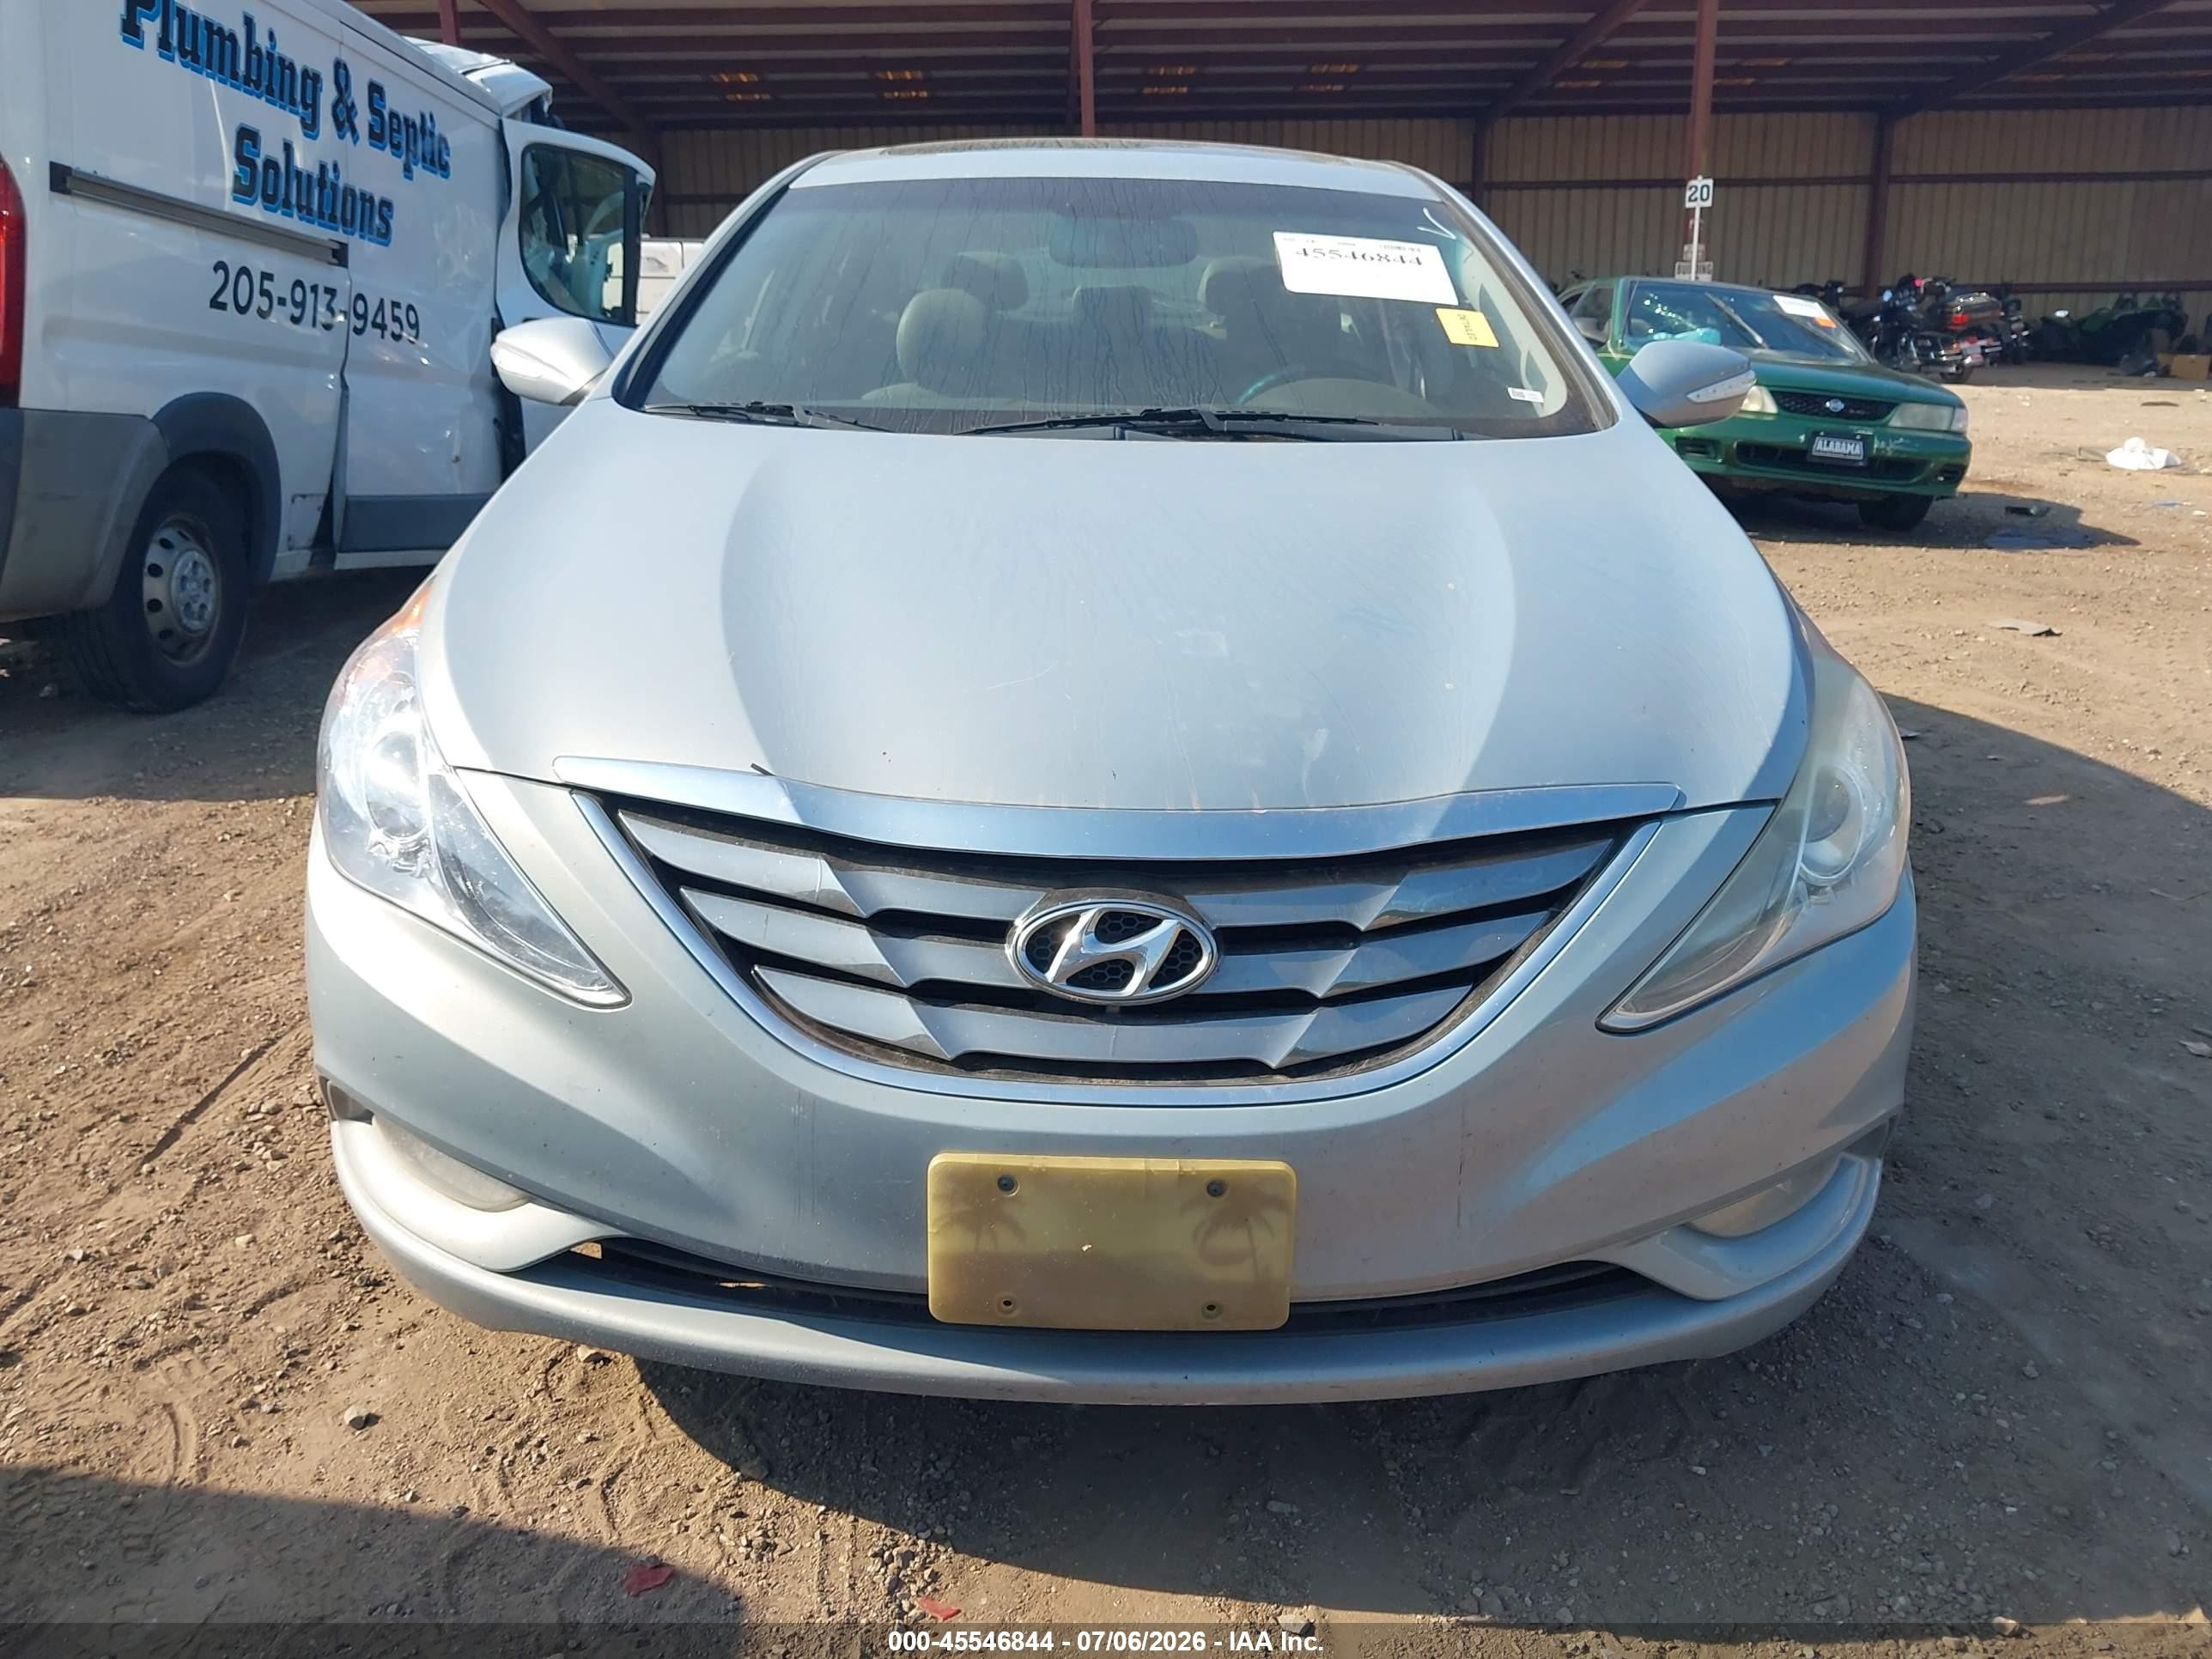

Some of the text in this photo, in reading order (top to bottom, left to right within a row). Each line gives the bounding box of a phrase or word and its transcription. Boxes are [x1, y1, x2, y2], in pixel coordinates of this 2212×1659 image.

[331, 57, 360, 146] &
[368, 78, 452, 181] Septic
[232, 123, 394, 246] Solutions
[1687, 183, 1711, 203] 20
[209, 259, 420, 344] 205-913-9459
[1815, 439, 1863, 456] ALABAMA
